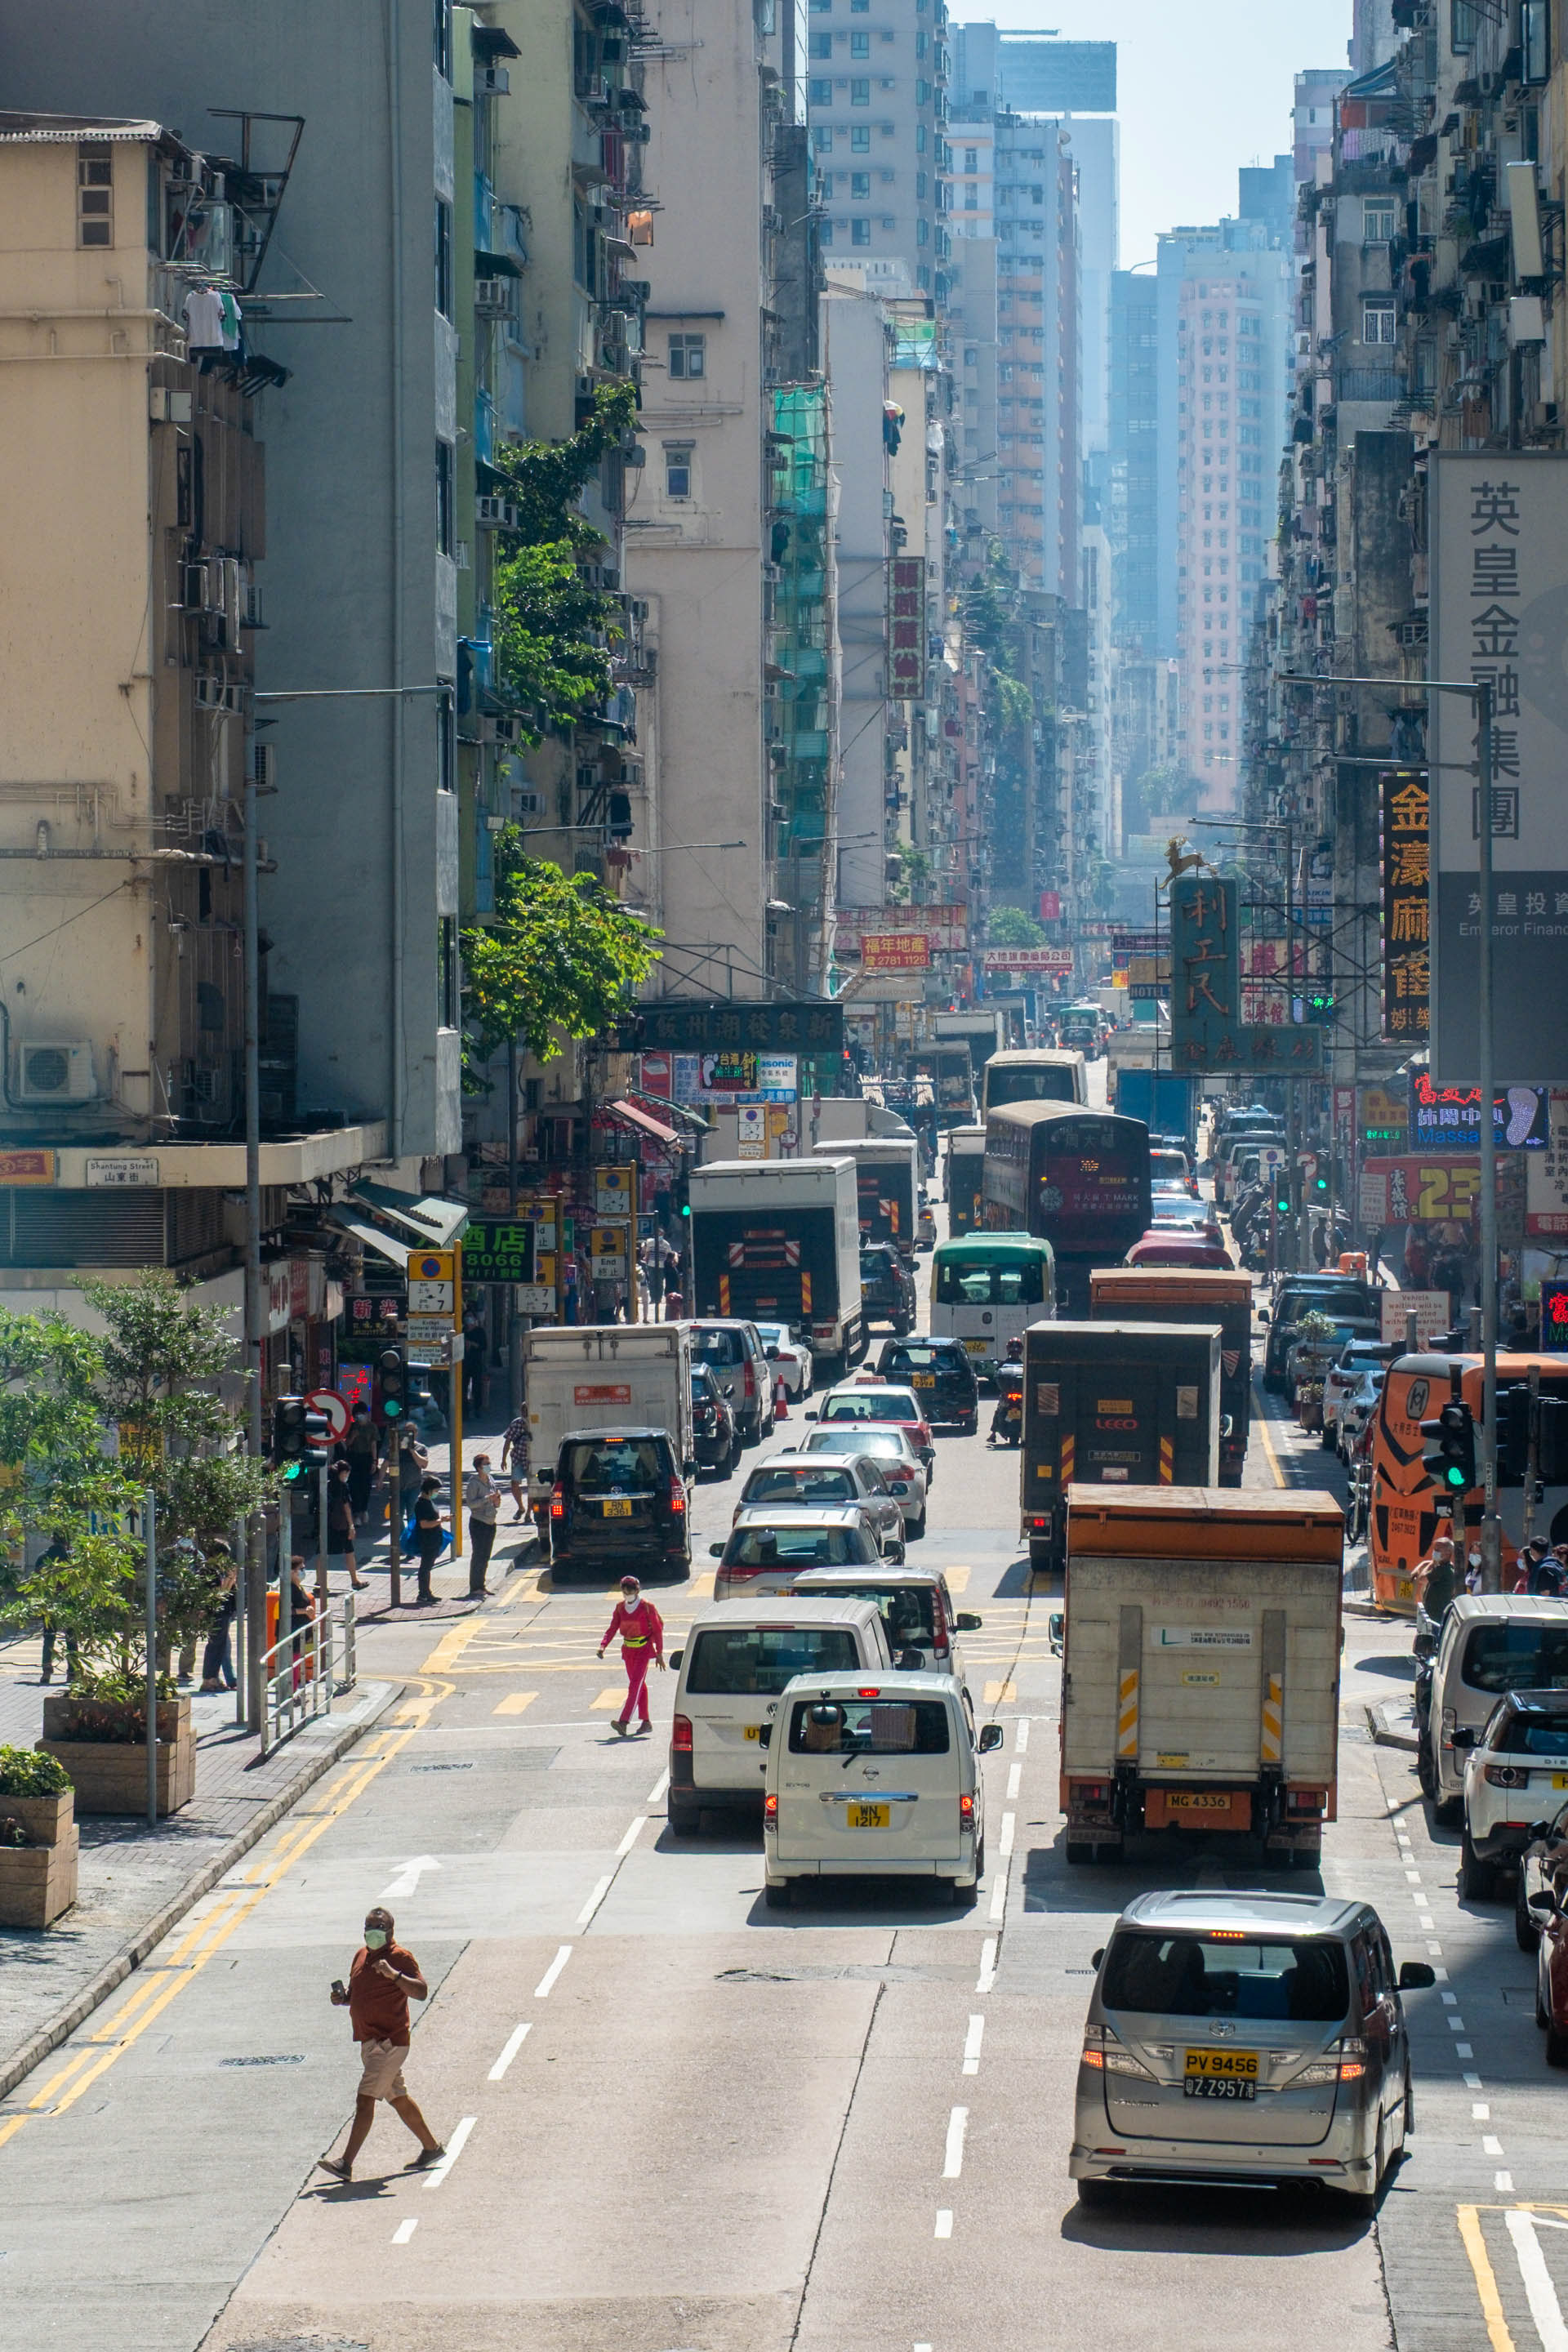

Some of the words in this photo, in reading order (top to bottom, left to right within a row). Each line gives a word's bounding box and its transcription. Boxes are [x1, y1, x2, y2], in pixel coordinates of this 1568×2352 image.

[1471, 482, 1521, 840] 英皇金融集團
[1459, 923, 1520, 935] Emeror
[866, 937, 926, 954] 福年地產
[878, 956, 901, 965] 2781
[904, 956, 926, 964] 1129
[1131, 987, 1166, 997] HOTEL
[1418, 1129, 1503, 1143] Massae
[91, 1162, 127, 1171] Shantung
[130, 1162, 154, 1170] Street
[105, 1172, 139, 1183] 山東街
[466, 1254, 522, 1267] 8066
[600, 1258, 617, 1266] End
[1171, 1797, 1190, 1807] MG
[1194, 1797, 1226, 1807] 4336
[860, 1805, 878, 1815] WN
[855, 1816, 881, 1827] 1217
[1187, 2056, 1209, 2070] PV
[1212, 2056, 1258, 2074] 9456
